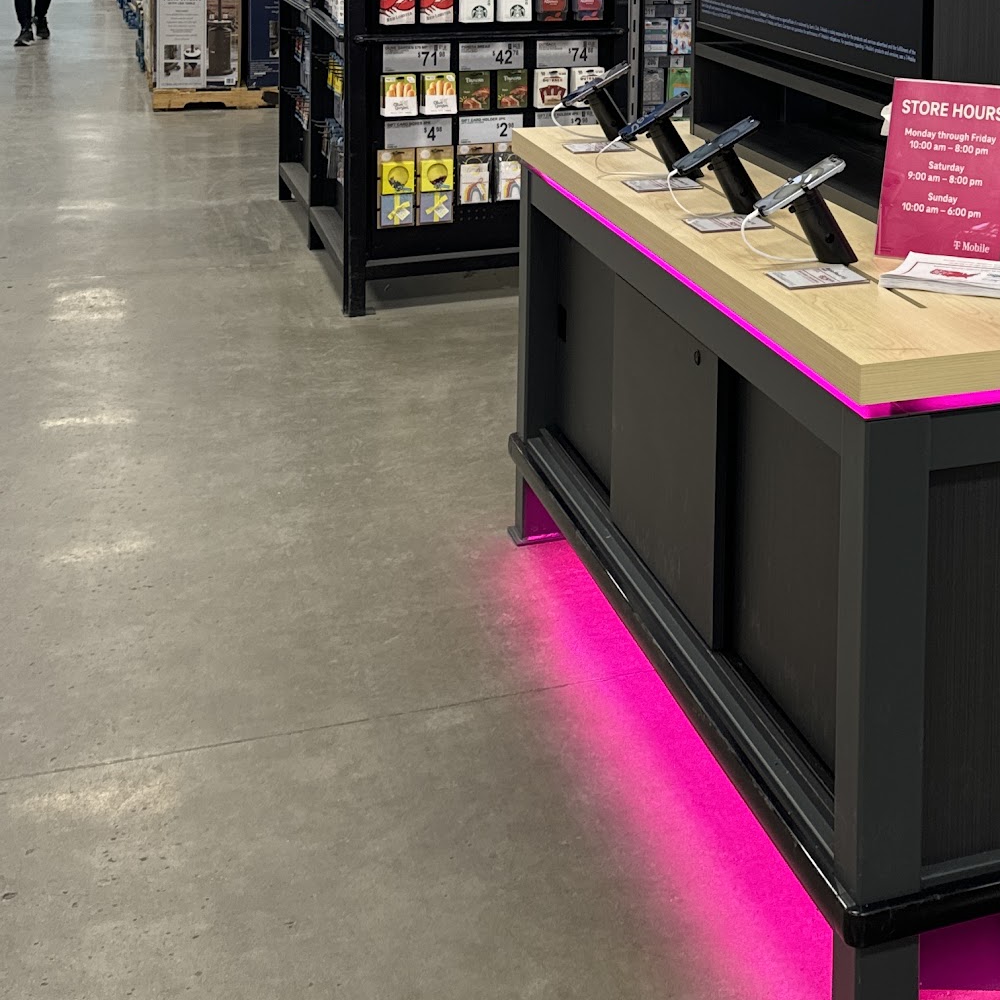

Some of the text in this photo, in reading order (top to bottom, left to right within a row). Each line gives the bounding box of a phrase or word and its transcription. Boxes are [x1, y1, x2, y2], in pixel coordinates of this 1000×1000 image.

[902, 99, 949, 117] STORE
[904, 128, 997, 145] Monday through Friday
[909, 140, 932, 150] 10:00
[955, 144, 974, 154] 8:00
[975, 147, 989, 156] pm
[928, 160, 965, 174] Saturday
[907, 171, 926, 181] 9:00
[928, 175, 941, 183] am
[949, 175, 968, 185] 8:00
[969, 178, 983, 187] pm
[927, 192, 958, 204] Sunday
[902, 202, 925, 212] 10:00
[926, 206, 939, 214] am
[947, 207, 967, 217] 6:00
[967, 210, 982, 219] pm
[962, 241, 990, 254] Mobile
